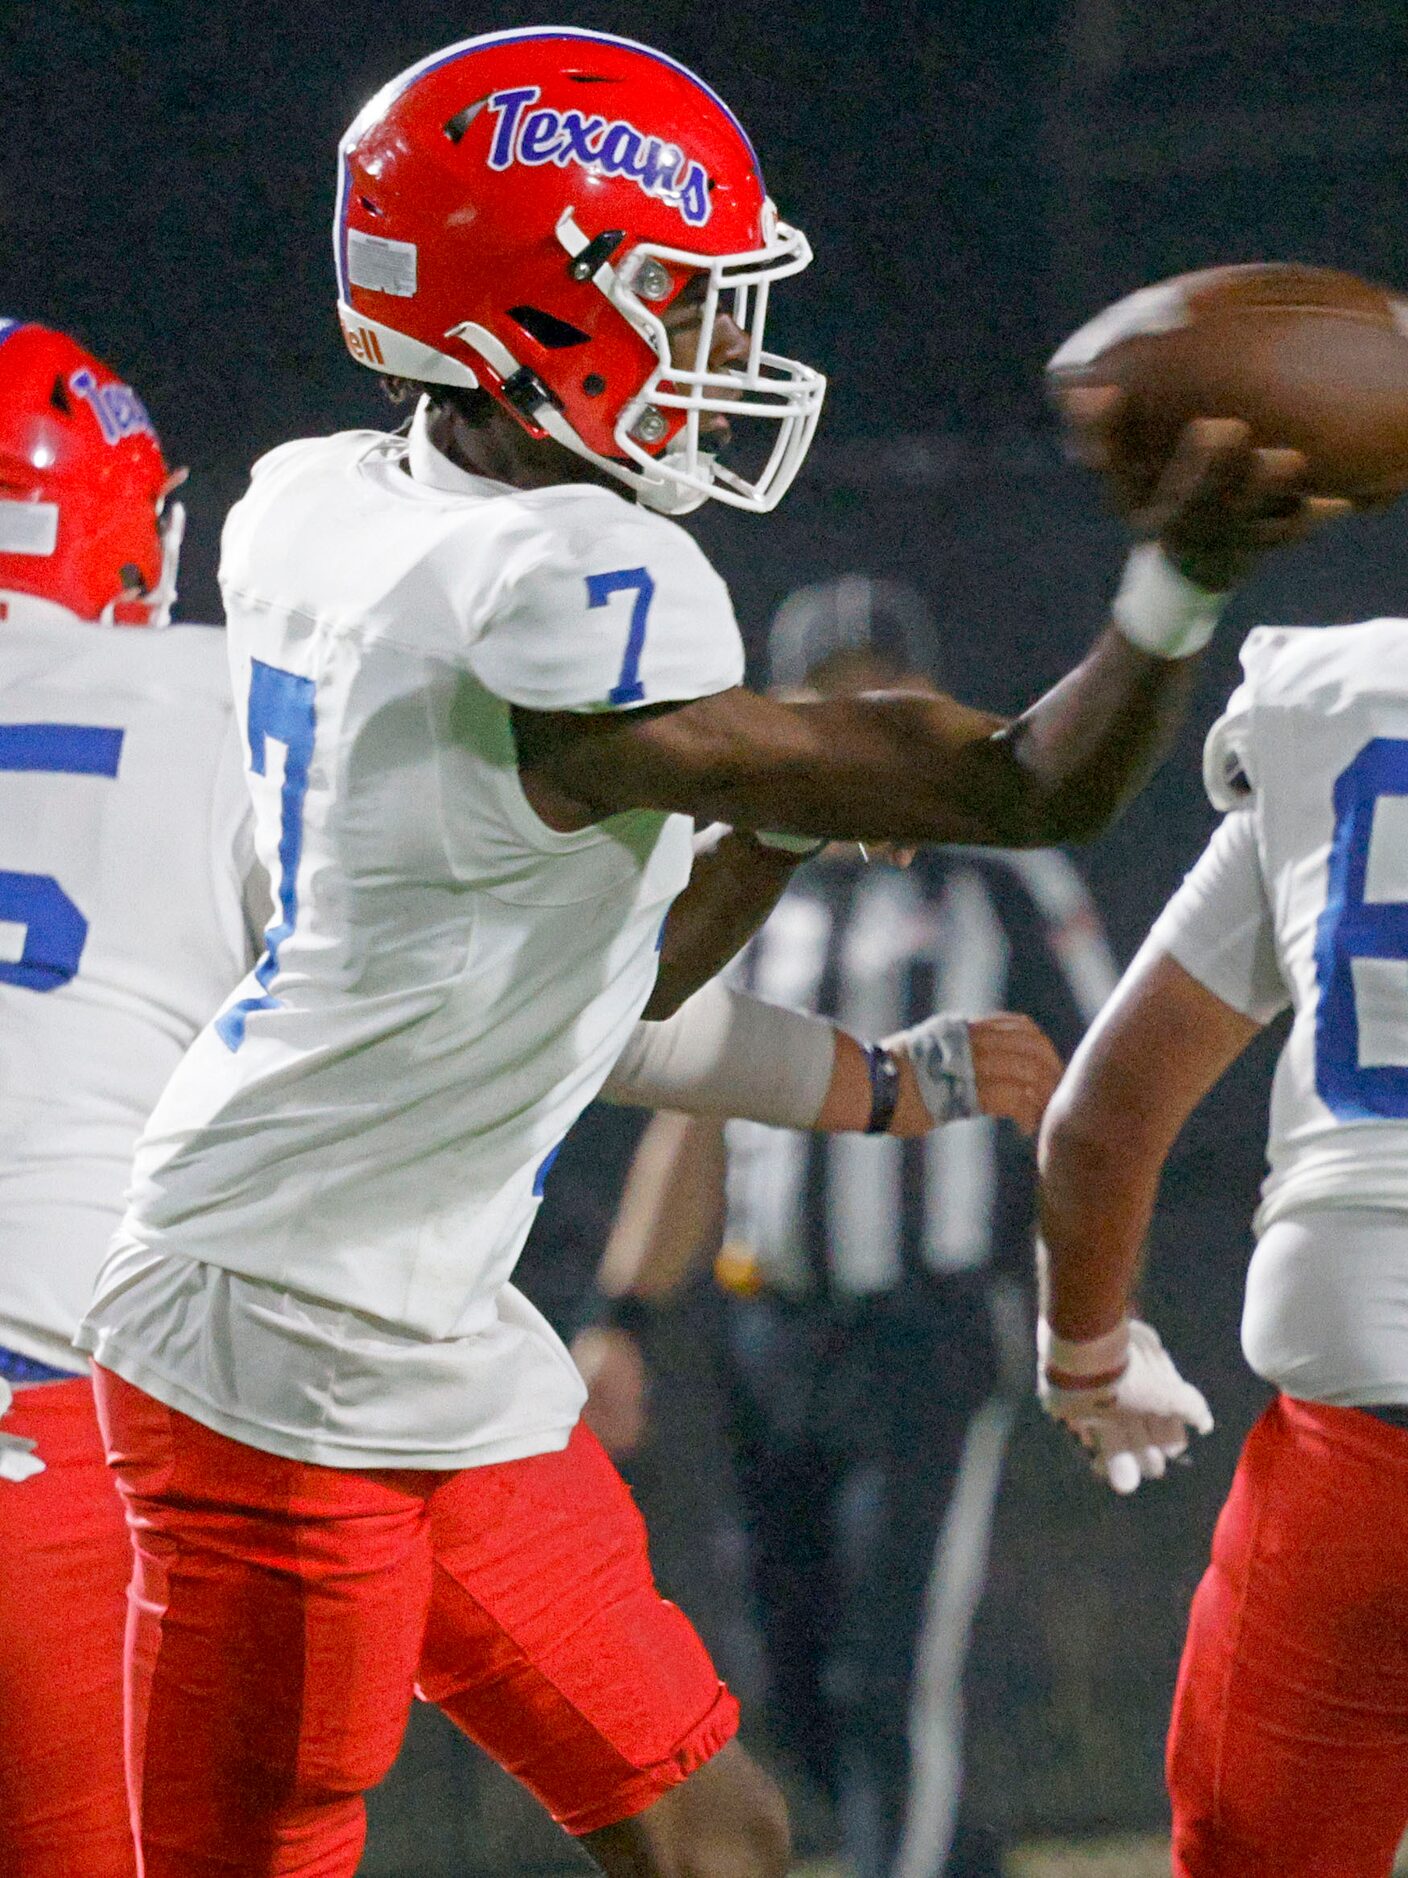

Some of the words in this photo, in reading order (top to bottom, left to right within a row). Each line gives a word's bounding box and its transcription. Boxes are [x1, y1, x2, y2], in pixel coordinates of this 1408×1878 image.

[487, 86, 711, 227] Texans
[585, 566, 656, 705] 7
[214, 656, 317, 1054] 7
